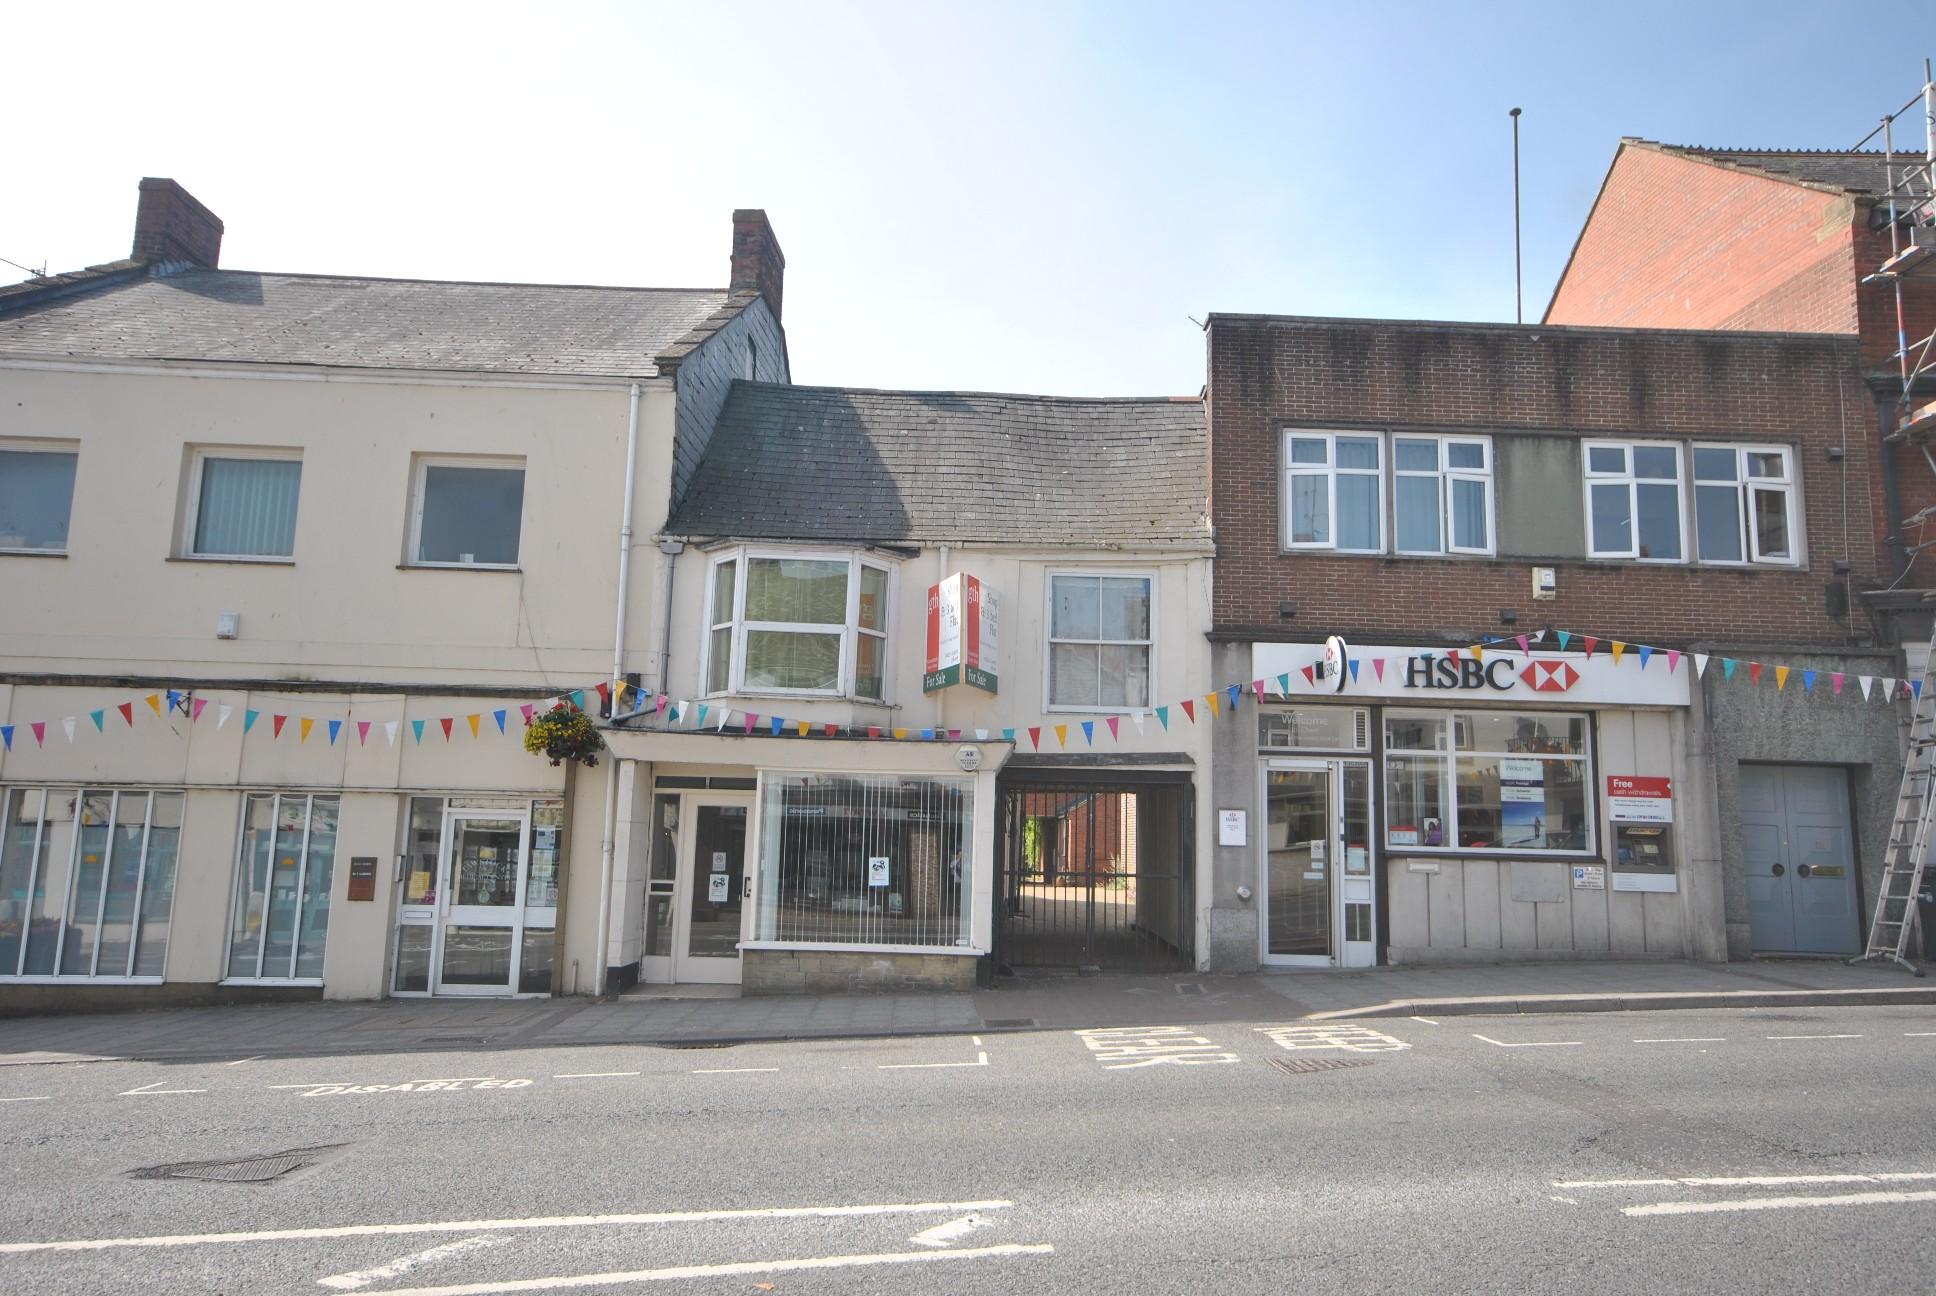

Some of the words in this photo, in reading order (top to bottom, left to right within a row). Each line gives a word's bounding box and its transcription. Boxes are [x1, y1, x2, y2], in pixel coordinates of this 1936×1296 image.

[928, 593, 939, 615] gth
[968, 586, 979, 604] gth
[1403, 656, 1515, 691] HSBC
[1613, 778, 1633, 788] Free
[1073, 1026, 1241, 1069] CLEAR
[1252, 1024, 1413, 1051] KEEP
[299, 1078, 534, 1097] DISABLED
